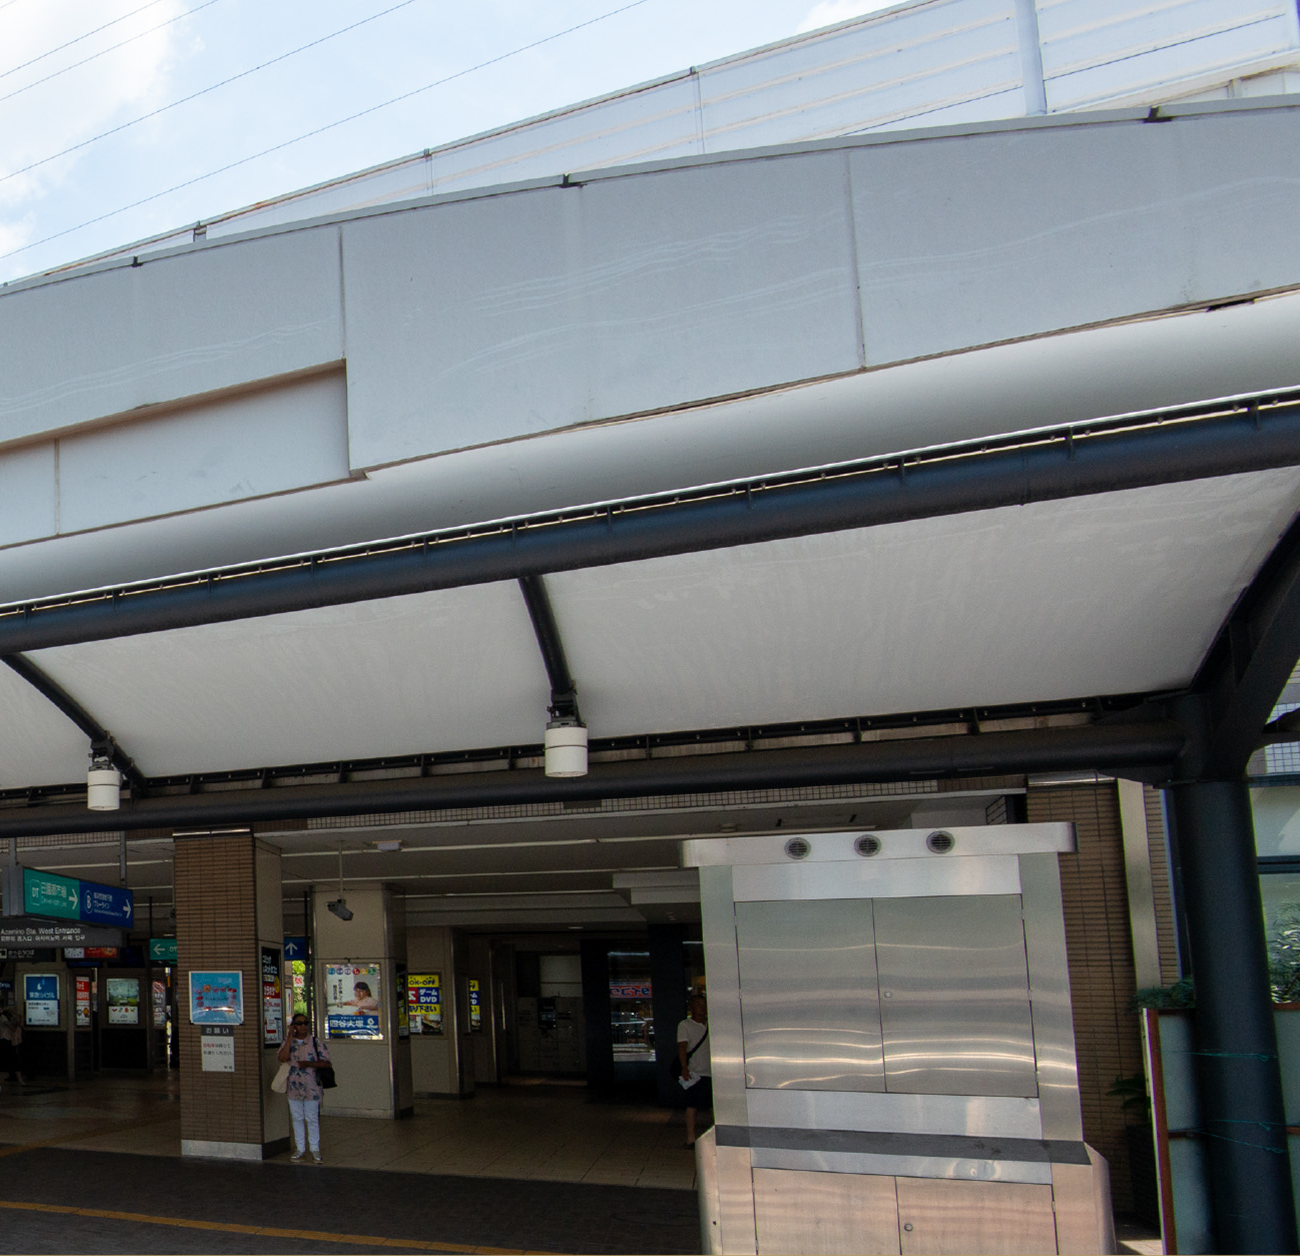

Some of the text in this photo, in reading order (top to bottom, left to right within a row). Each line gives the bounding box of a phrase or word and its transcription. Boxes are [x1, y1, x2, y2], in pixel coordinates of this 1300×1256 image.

[31, 887, 40, 898] DT
[39, 927, 54, 935] West
[54, 927, 81, 935] Entrance
[419, 988, 438, 996] ゲーム
[329, 1020, 364, 1028] 四谷大塚
